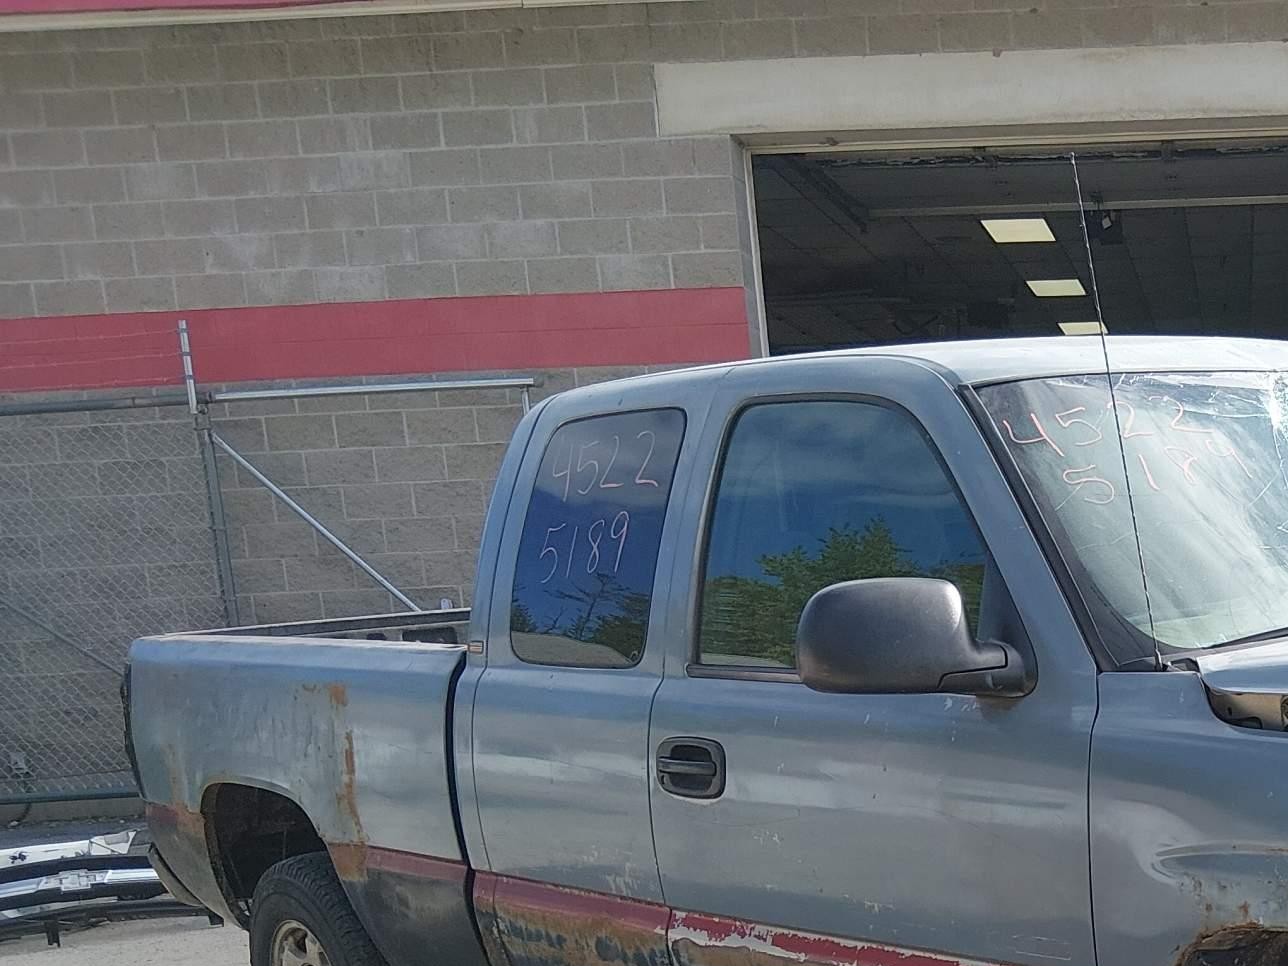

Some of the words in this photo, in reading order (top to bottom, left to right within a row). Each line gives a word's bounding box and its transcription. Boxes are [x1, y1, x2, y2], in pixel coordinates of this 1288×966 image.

[1002, 395, 1214, 457] 4522
[551, 430, 659, 503] 4522
[538, 509, 631, 584] 5189
